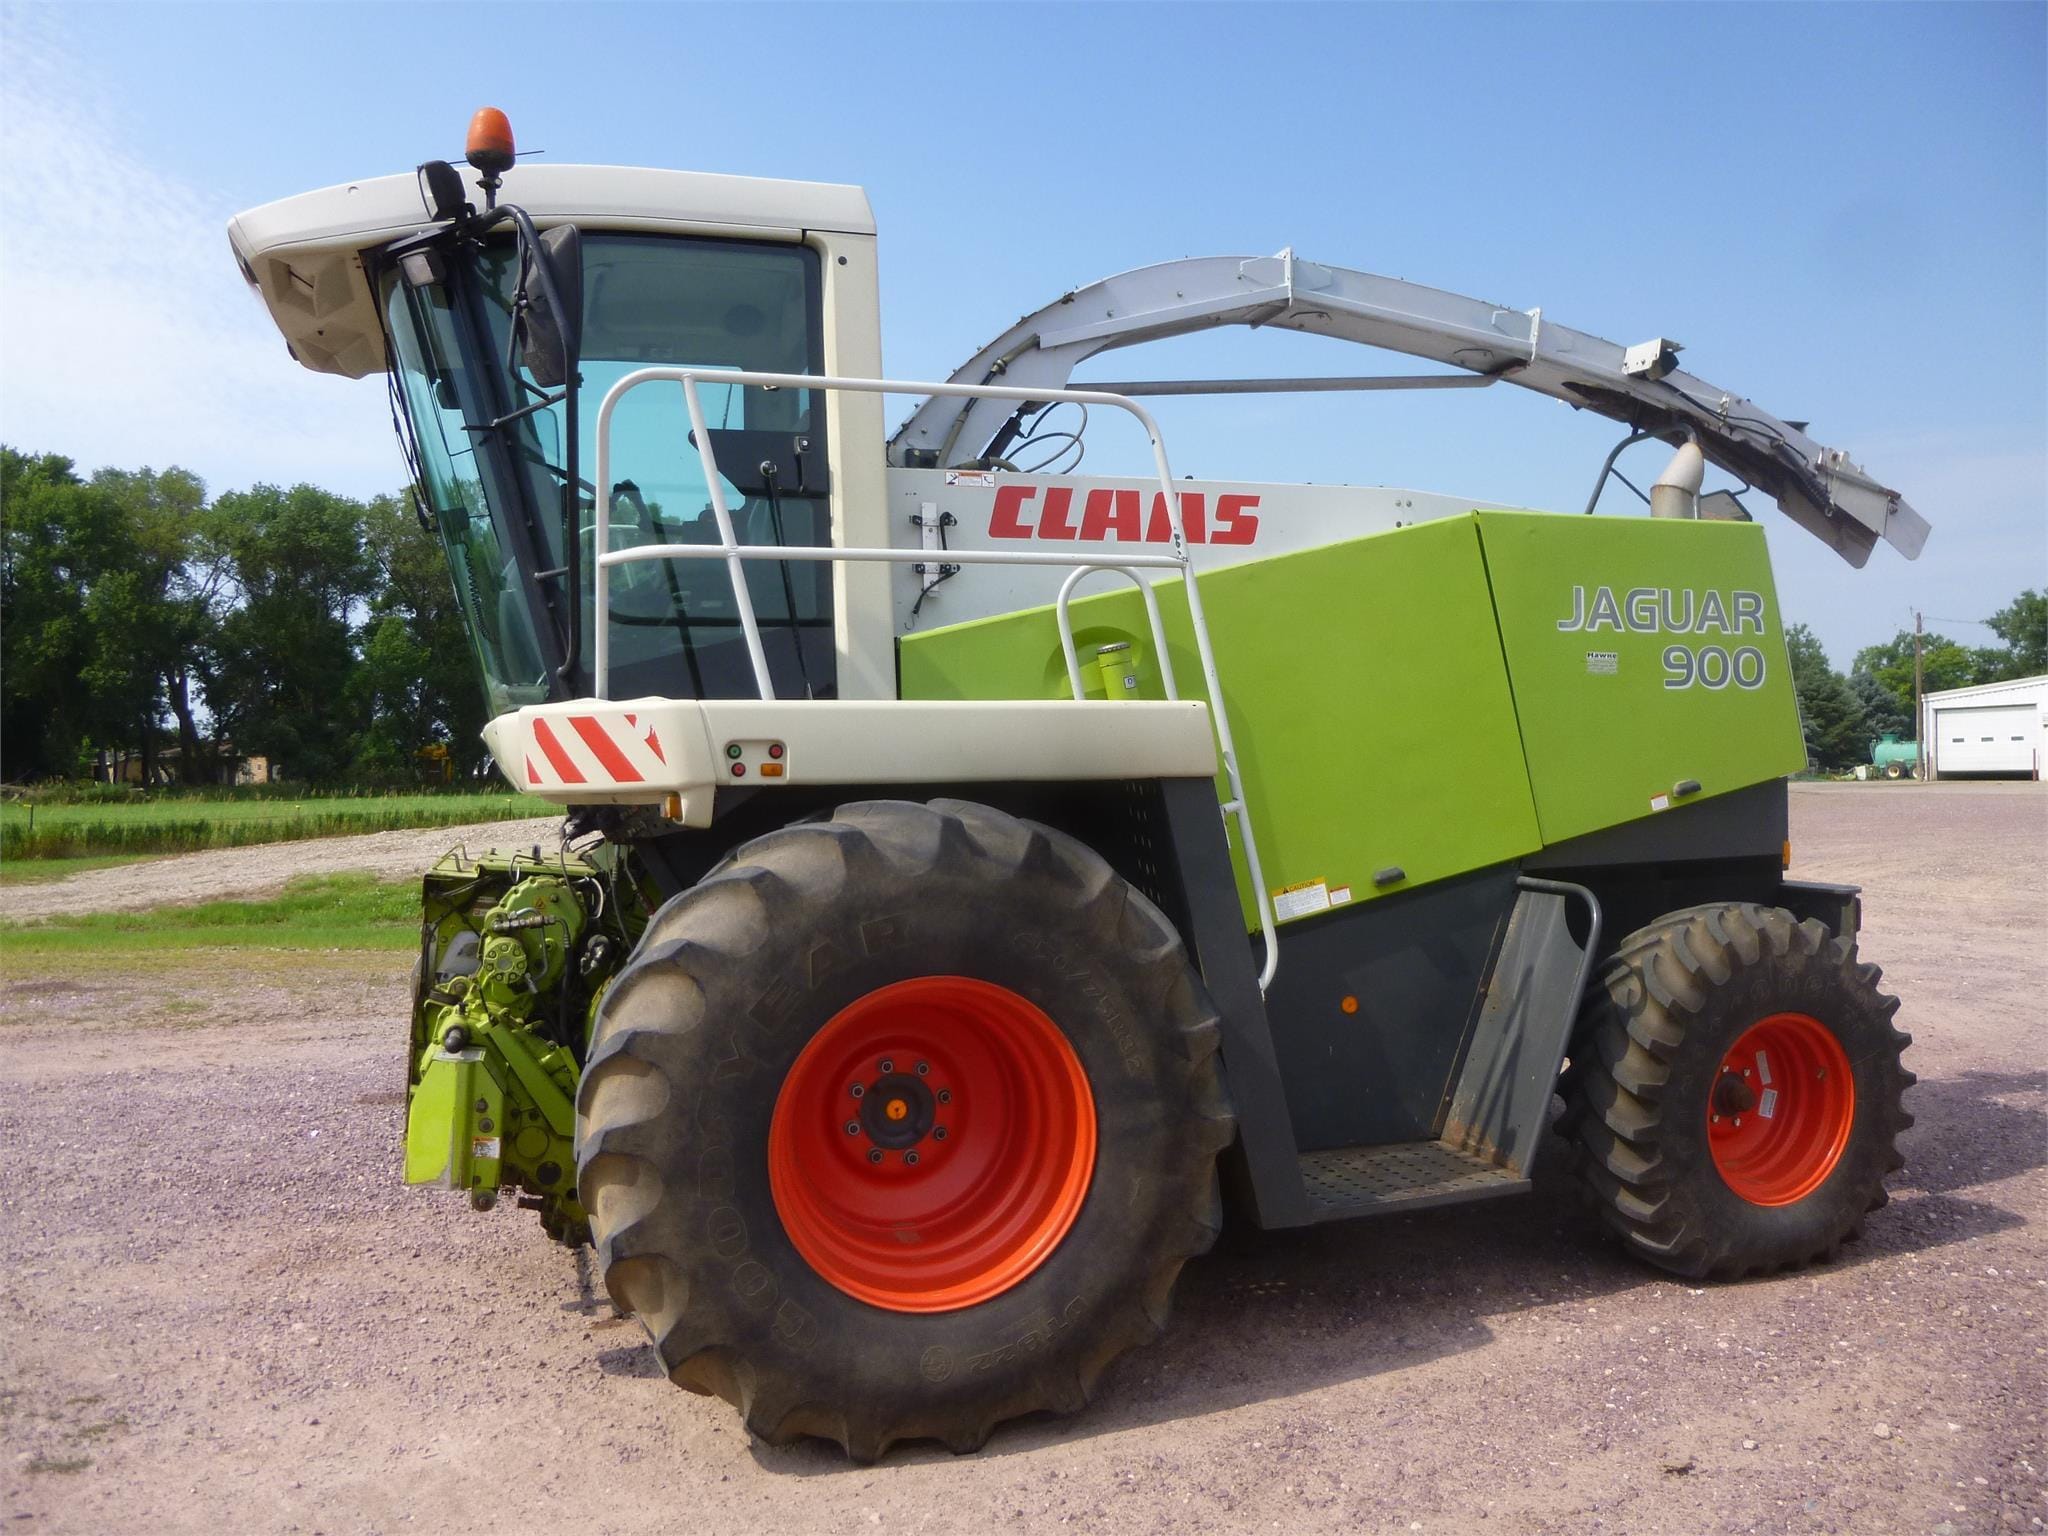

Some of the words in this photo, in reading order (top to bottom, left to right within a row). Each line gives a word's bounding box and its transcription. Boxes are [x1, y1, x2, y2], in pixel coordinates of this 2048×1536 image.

[988, 485, 1261, 545] CLAAS
[1557, 585, 1765, 635] JAGUAR
[1662, 644, 1766, 690] 900
[1288, 879, 1316, 892] CAUTION
